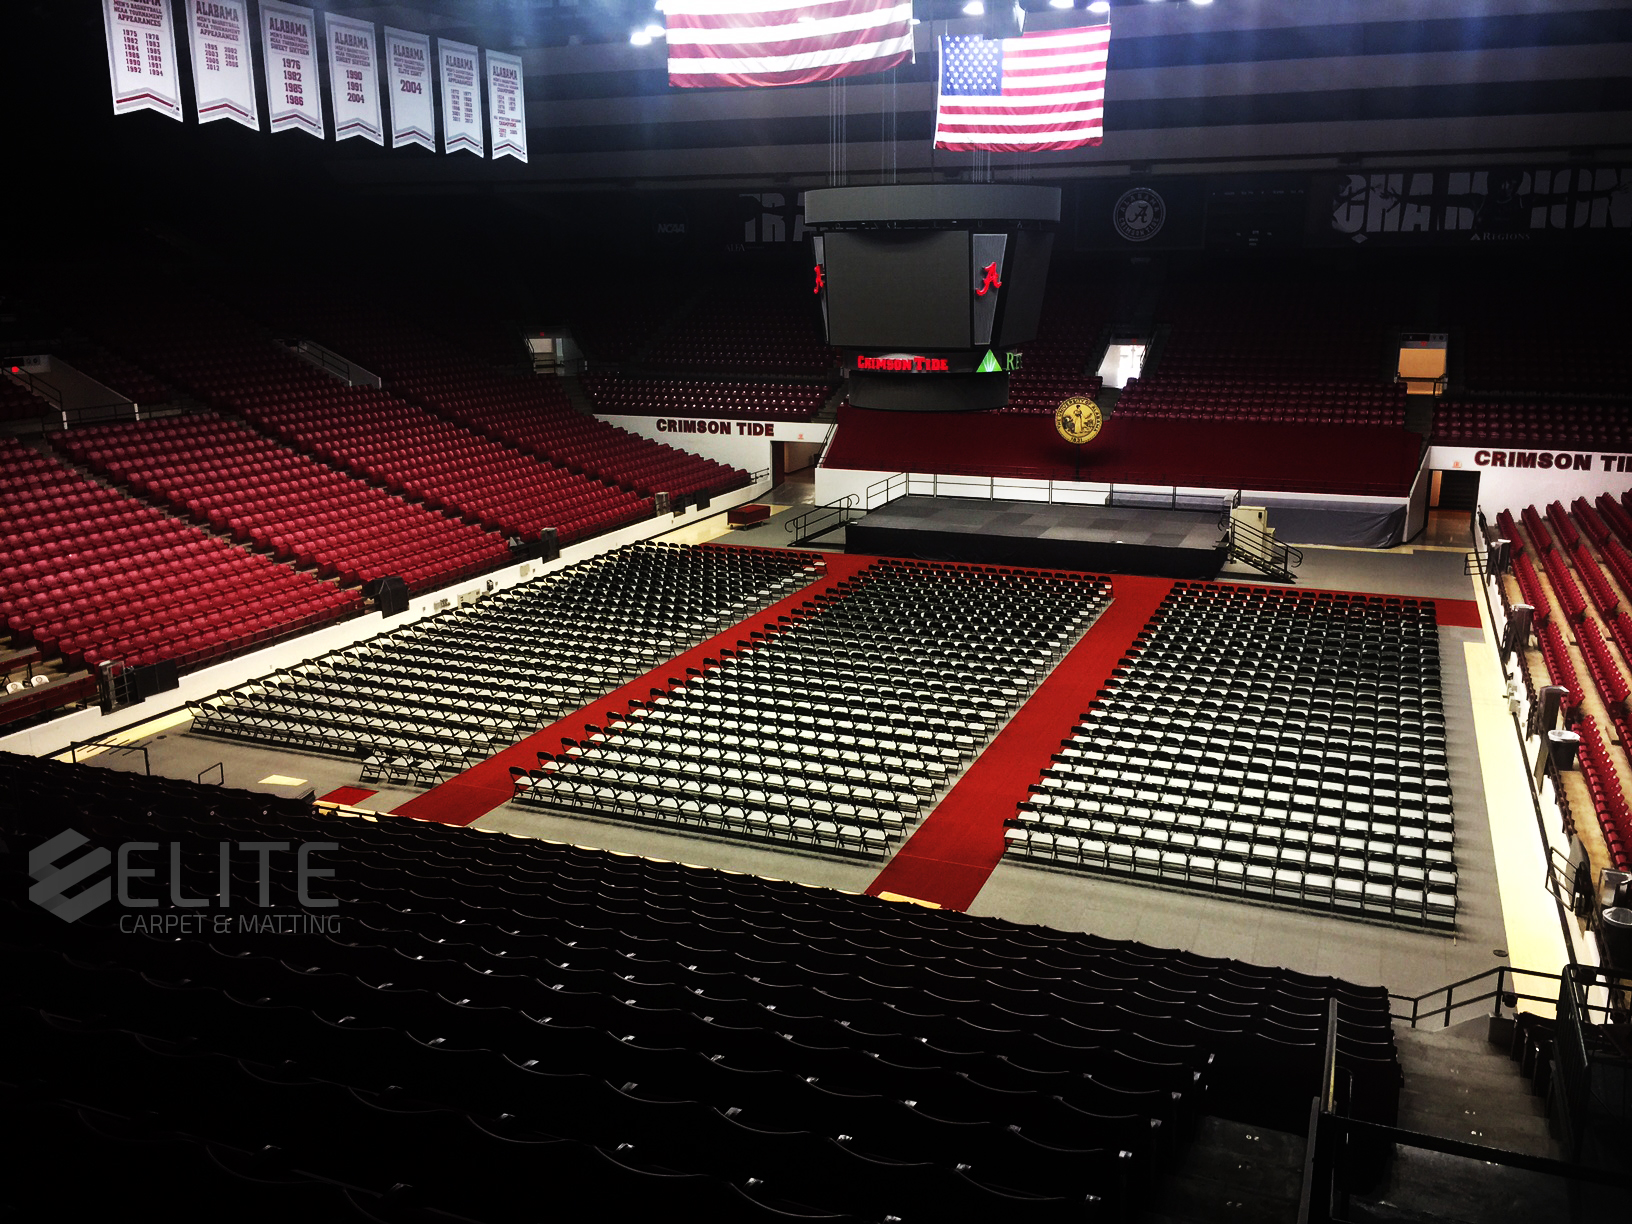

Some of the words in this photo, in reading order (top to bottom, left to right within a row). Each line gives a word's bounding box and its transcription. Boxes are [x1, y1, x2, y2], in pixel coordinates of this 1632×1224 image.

[130, 3, 162, 14] BASKETBALL
[130, 10, 163, 20] TOURNAMENT
[196, 1, 239, 22] ALABAMA
[118, 14, 161, 27] APPEARANCES
[270, 17, 307, 37] ALABAMA
[200, 28, 238, 41] APPEARANCES
[335, 32, 369, 49] ALABAMA
[271, 43, 288, 51] SWEET
[393, 44, 424, 60] ALABAMA
[282, 58, 301, 70] 1976
[446, 55, 473, 71] ALABAMA
[283, 70, 302, 82] 1982
[346, 70, 363, 80] 1990
[493, 66, 518, 80] ALABAMA
[284, 82, 302, 94] 1985
[347, 81, 363, 92] 1991
[400, 80, 422, 94] 2004
[286, 95, 304, 106] 1986
[347, 93, 364, 103] 2004
[1120, 193, 1160, 212] ALABAMA
[657, 223, 685, 233] NCAA
[656, 419, 731, 434] CRIMSON
[736, 422, 774, 436] TIDE
[1474, 450, 1592, 471] CRIMSON
